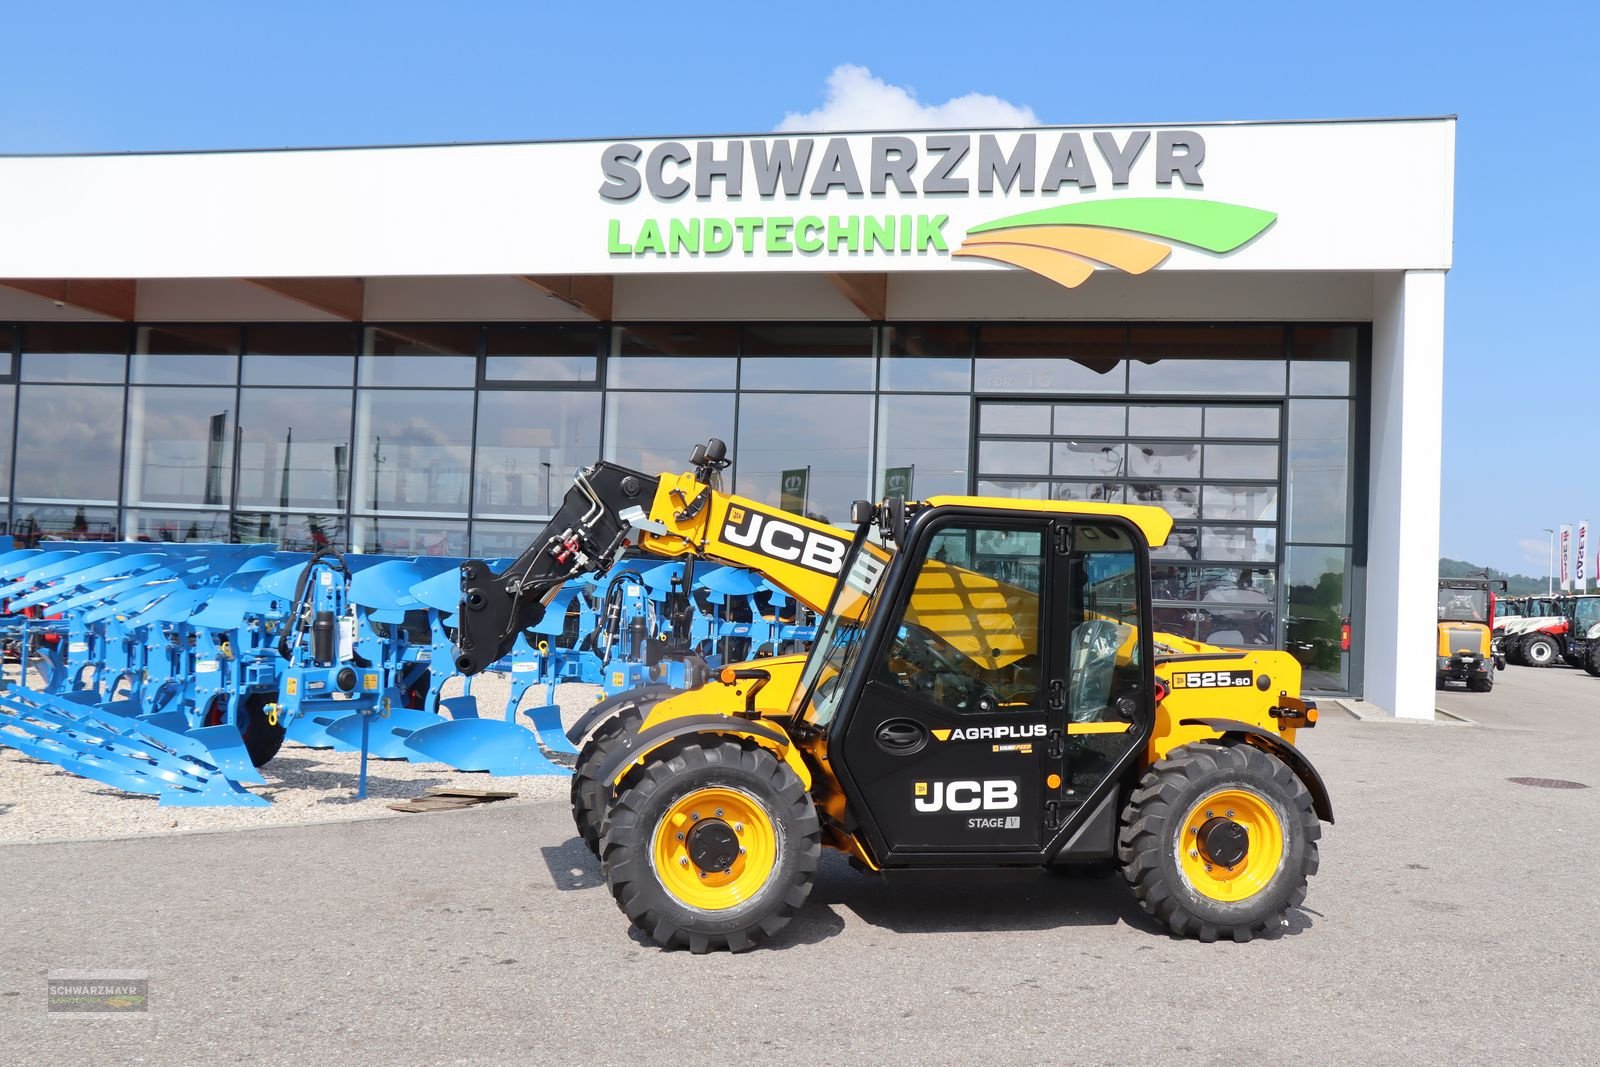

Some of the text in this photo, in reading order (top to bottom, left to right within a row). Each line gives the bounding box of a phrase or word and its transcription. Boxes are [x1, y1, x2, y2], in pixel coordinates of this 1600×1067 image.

[599, 130, 1207, 200] SCHWARZMAYR
[607, 213, 951, 257] LANDTECHNIK
[724, 513, 846, 574] JCB
[951, 724, 1048, 741] AGRIPLUS
[914, 780, 1018, 812] JCB
[968, 817, 1004, 828] STAGE
